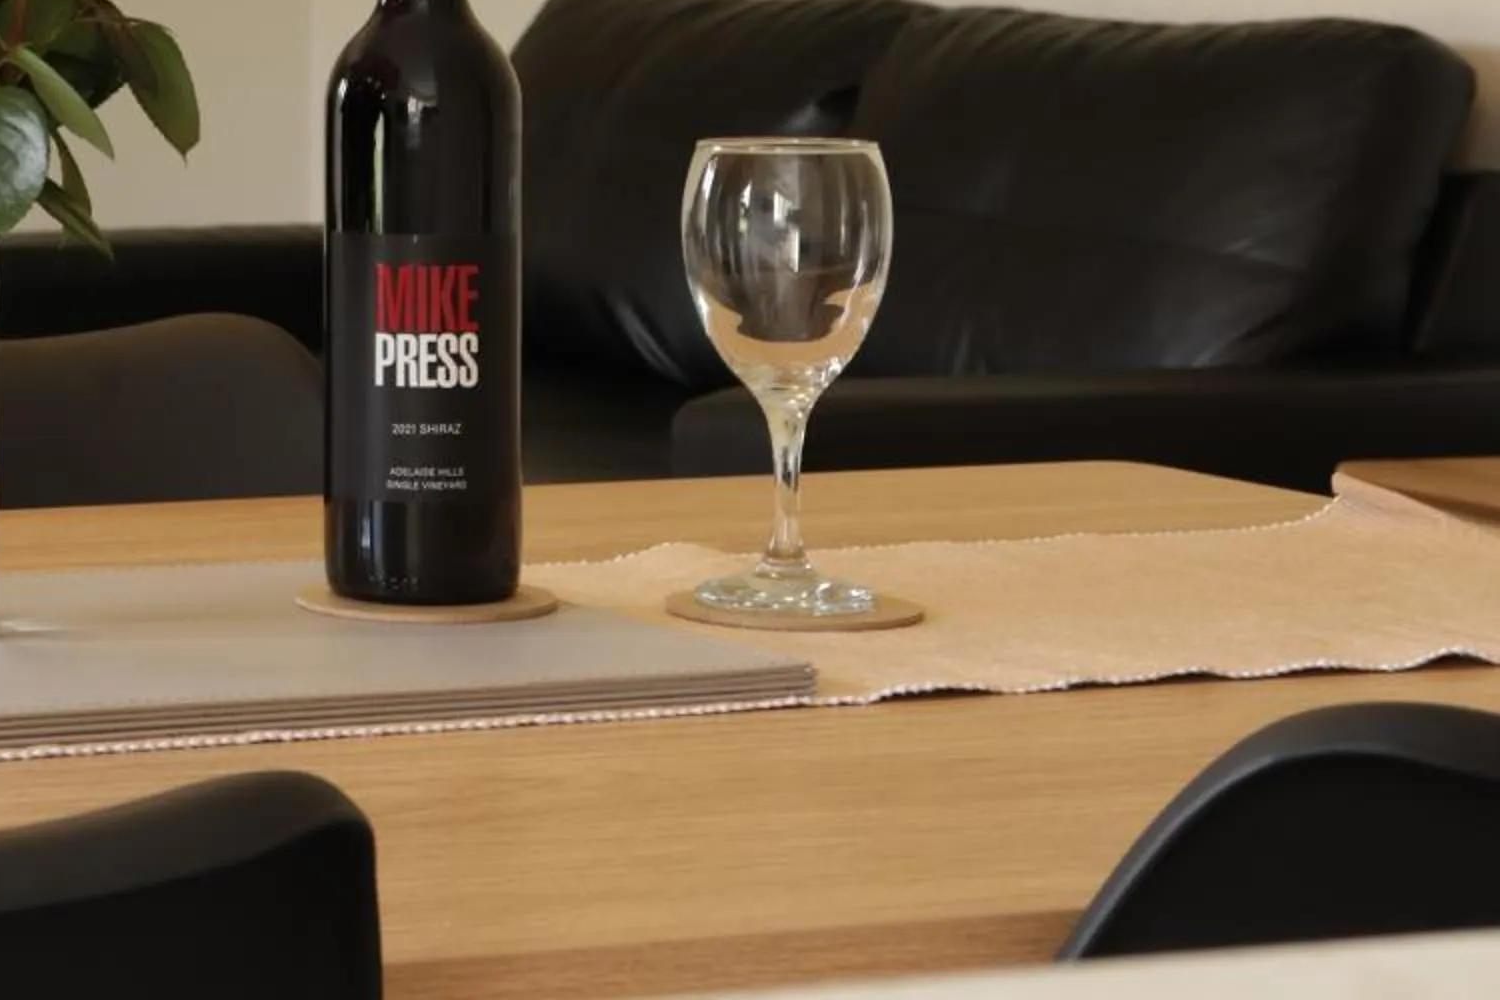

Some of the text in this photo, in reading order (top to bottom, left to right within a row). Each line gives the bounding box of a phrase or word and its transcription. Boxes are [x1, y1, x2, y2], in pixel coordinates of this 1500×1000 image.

[374, 263, 479, 332] MIKE
[374, 332, 479, 388] PRESS
[391, 423, 462, 435] 2021 SHIRAZ
[389, 467, 435, 477] ADELAIDE
